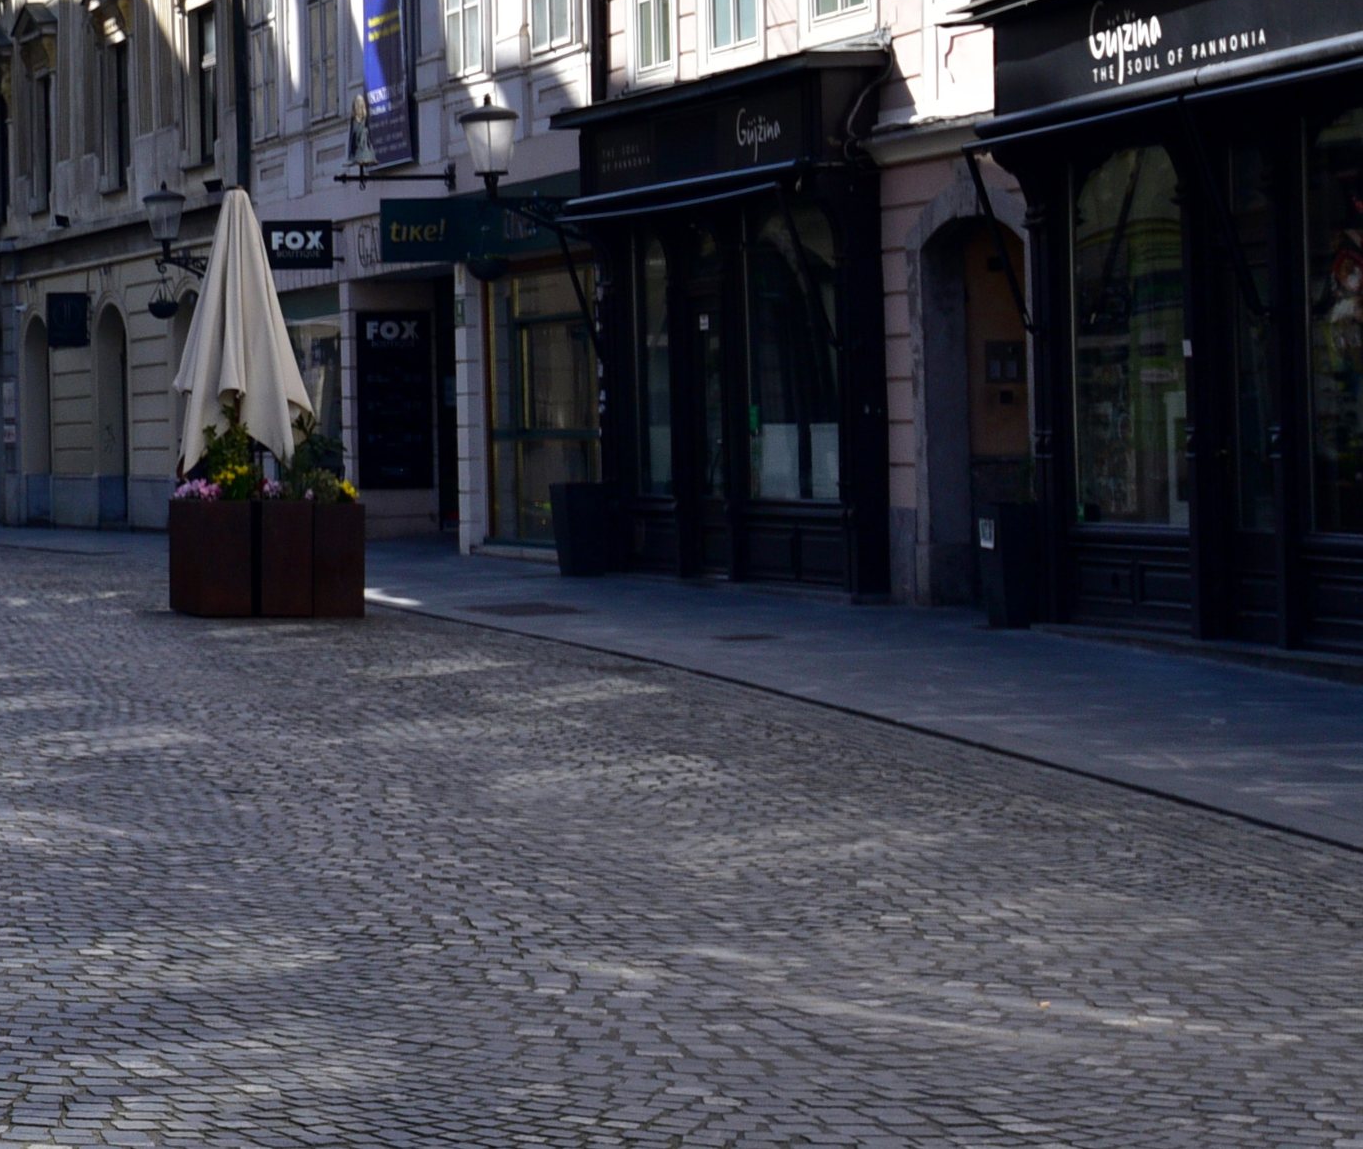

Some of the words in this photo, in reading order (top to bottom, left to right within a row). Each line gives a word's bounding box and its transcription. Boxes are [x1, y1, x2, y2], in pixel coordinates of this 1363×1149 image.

[1092, 64, 1114, 83] THE
[1127, 54, 1160, 76] SOUL
[1168, 47, 1183, 66] OF
[1191, 28, 1266, 60] PANNONIA
[271, 231, 324, 251] FOX
[366, 320, 419, 340] FOX
